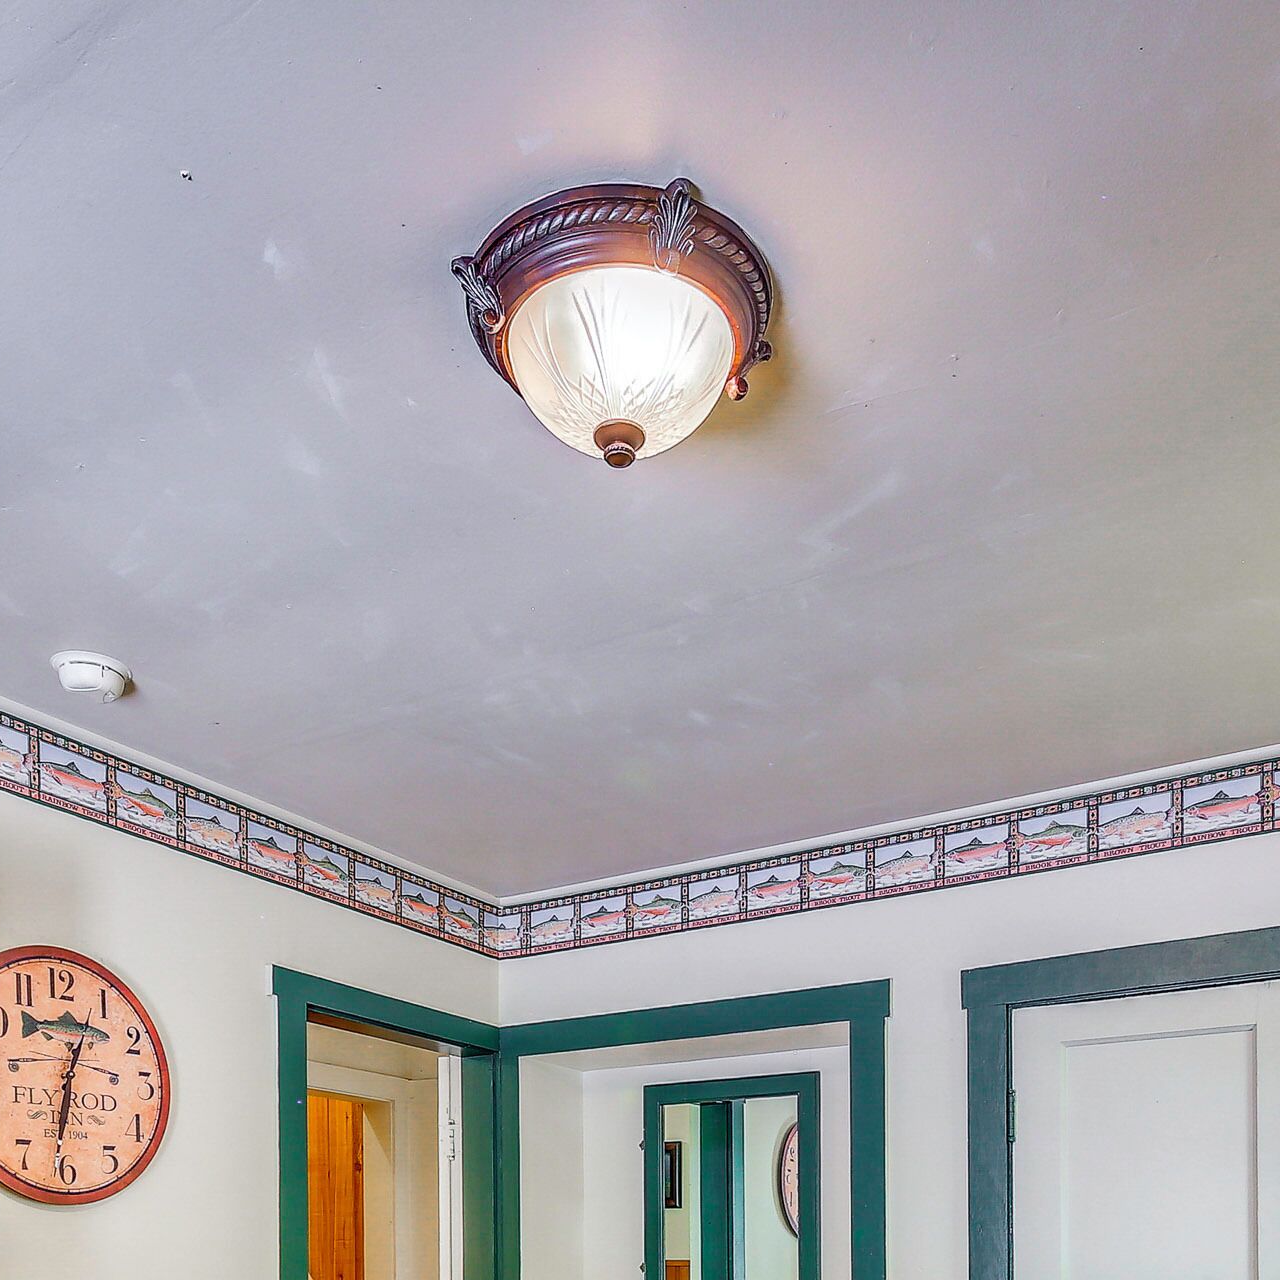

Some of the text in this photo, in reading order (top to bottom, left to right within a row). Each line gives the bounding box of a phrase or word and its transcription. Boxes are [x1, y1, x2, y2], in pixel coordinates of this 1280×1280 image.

[41, 793, 107, 822] RAINBOW TROUT
[122, 821, 173, 844] BROOK TROUT
[1184, 824, 1260, 844] RAINBOW TROUT
[1025, 856, 1082, 871] BROOK TROUT
[1103, 840, 1168, 858] BROWN TROUT
[878, 882, 932, 896] BROWN TROUT
[945, 869, 1008, 885] RAINBOW TROUT
[814, 894, 862, 907] BROOK TROUT
[13, 971, 35, 1008] 11
[48, 966, 75, 1003] 12
[99, 988, 109, 1020] 1
[125, 1025, 141, 1056] 2
[12, 1085, 118, 1113] FLY ROD
[137, 1071, 156, 1101] 3
[69, 1130, 88, 1140] 1904
[124, 1113, 145, 1144] 4
[15, 1138, 33, 1171] 7
[101, 1145, 119, 1176] 5
[58, 1154, 77, 1186] 6
